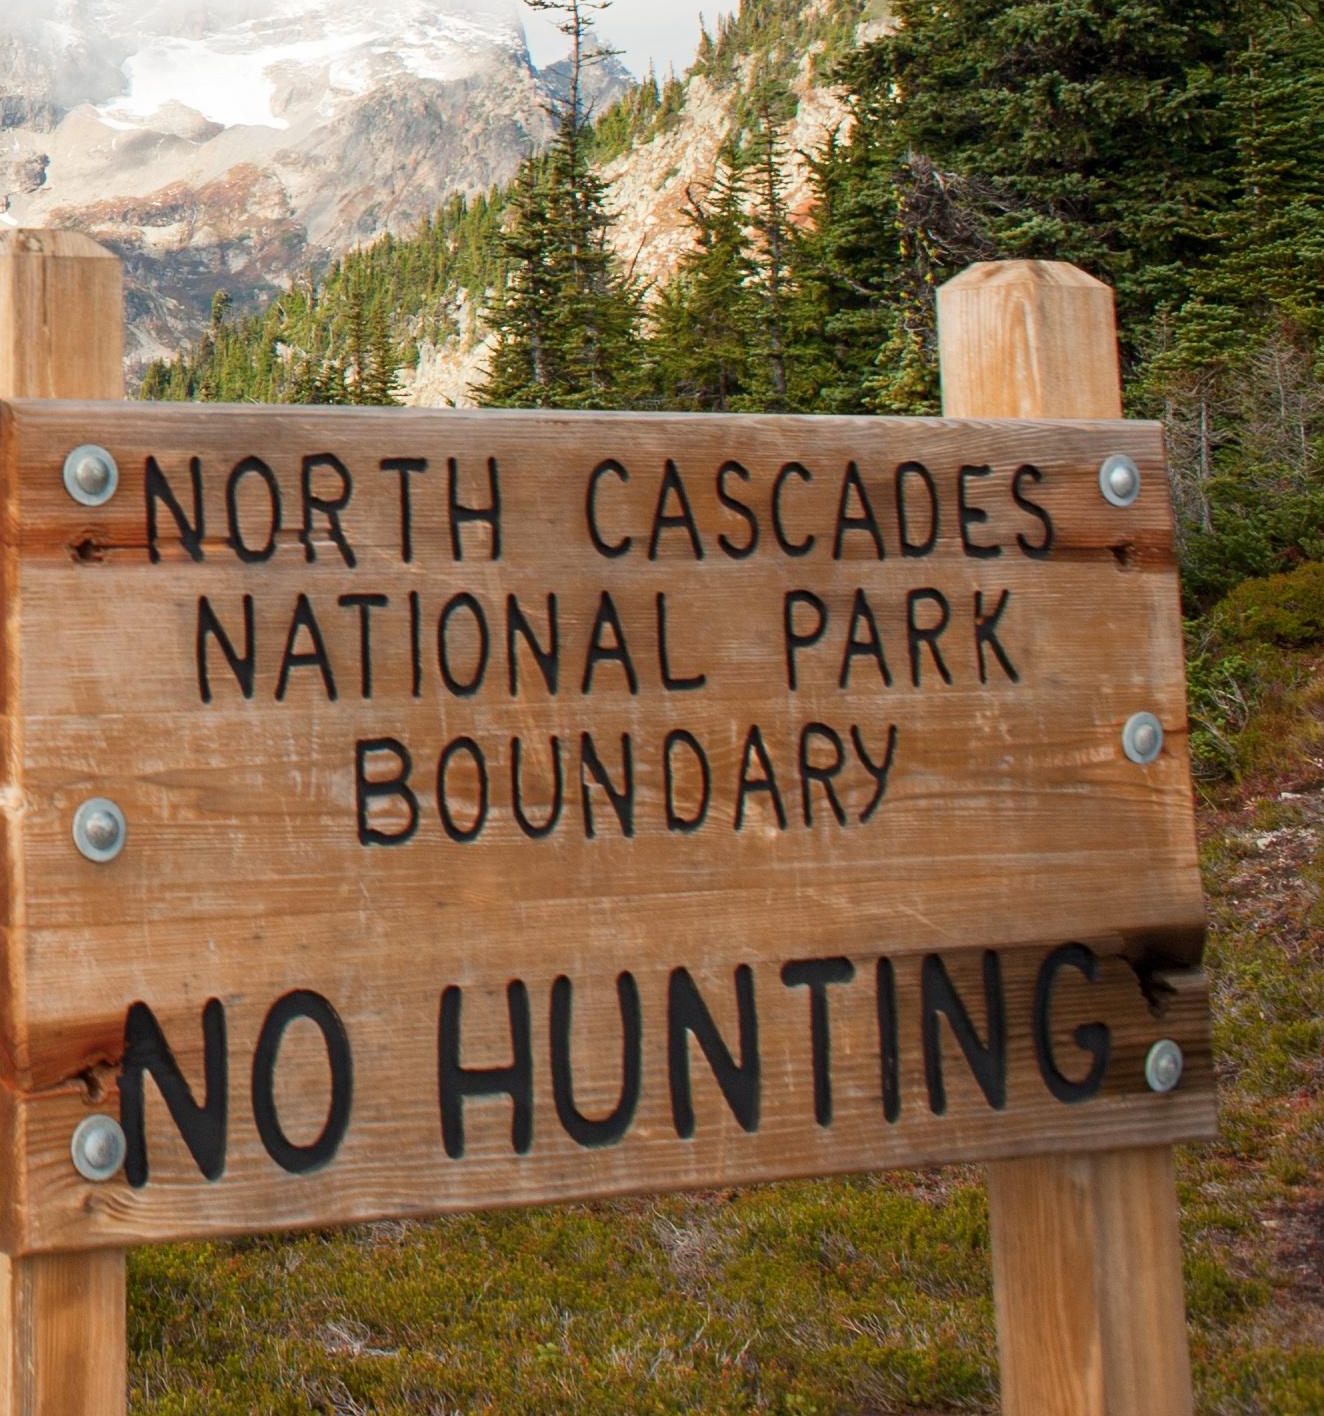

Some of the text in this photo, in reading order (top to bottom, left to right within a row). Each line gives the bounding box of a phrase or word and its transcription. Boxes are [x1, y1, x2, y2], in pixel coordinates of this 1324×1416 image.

[144, 453, 1055, 568] NORTH CASCADES
[196, 588, 1019, 702] NATIONAL PARK
[355, 722, 897, 847] BOUNDARY
[119, 941, 1111, 1188] NO HUNTING
